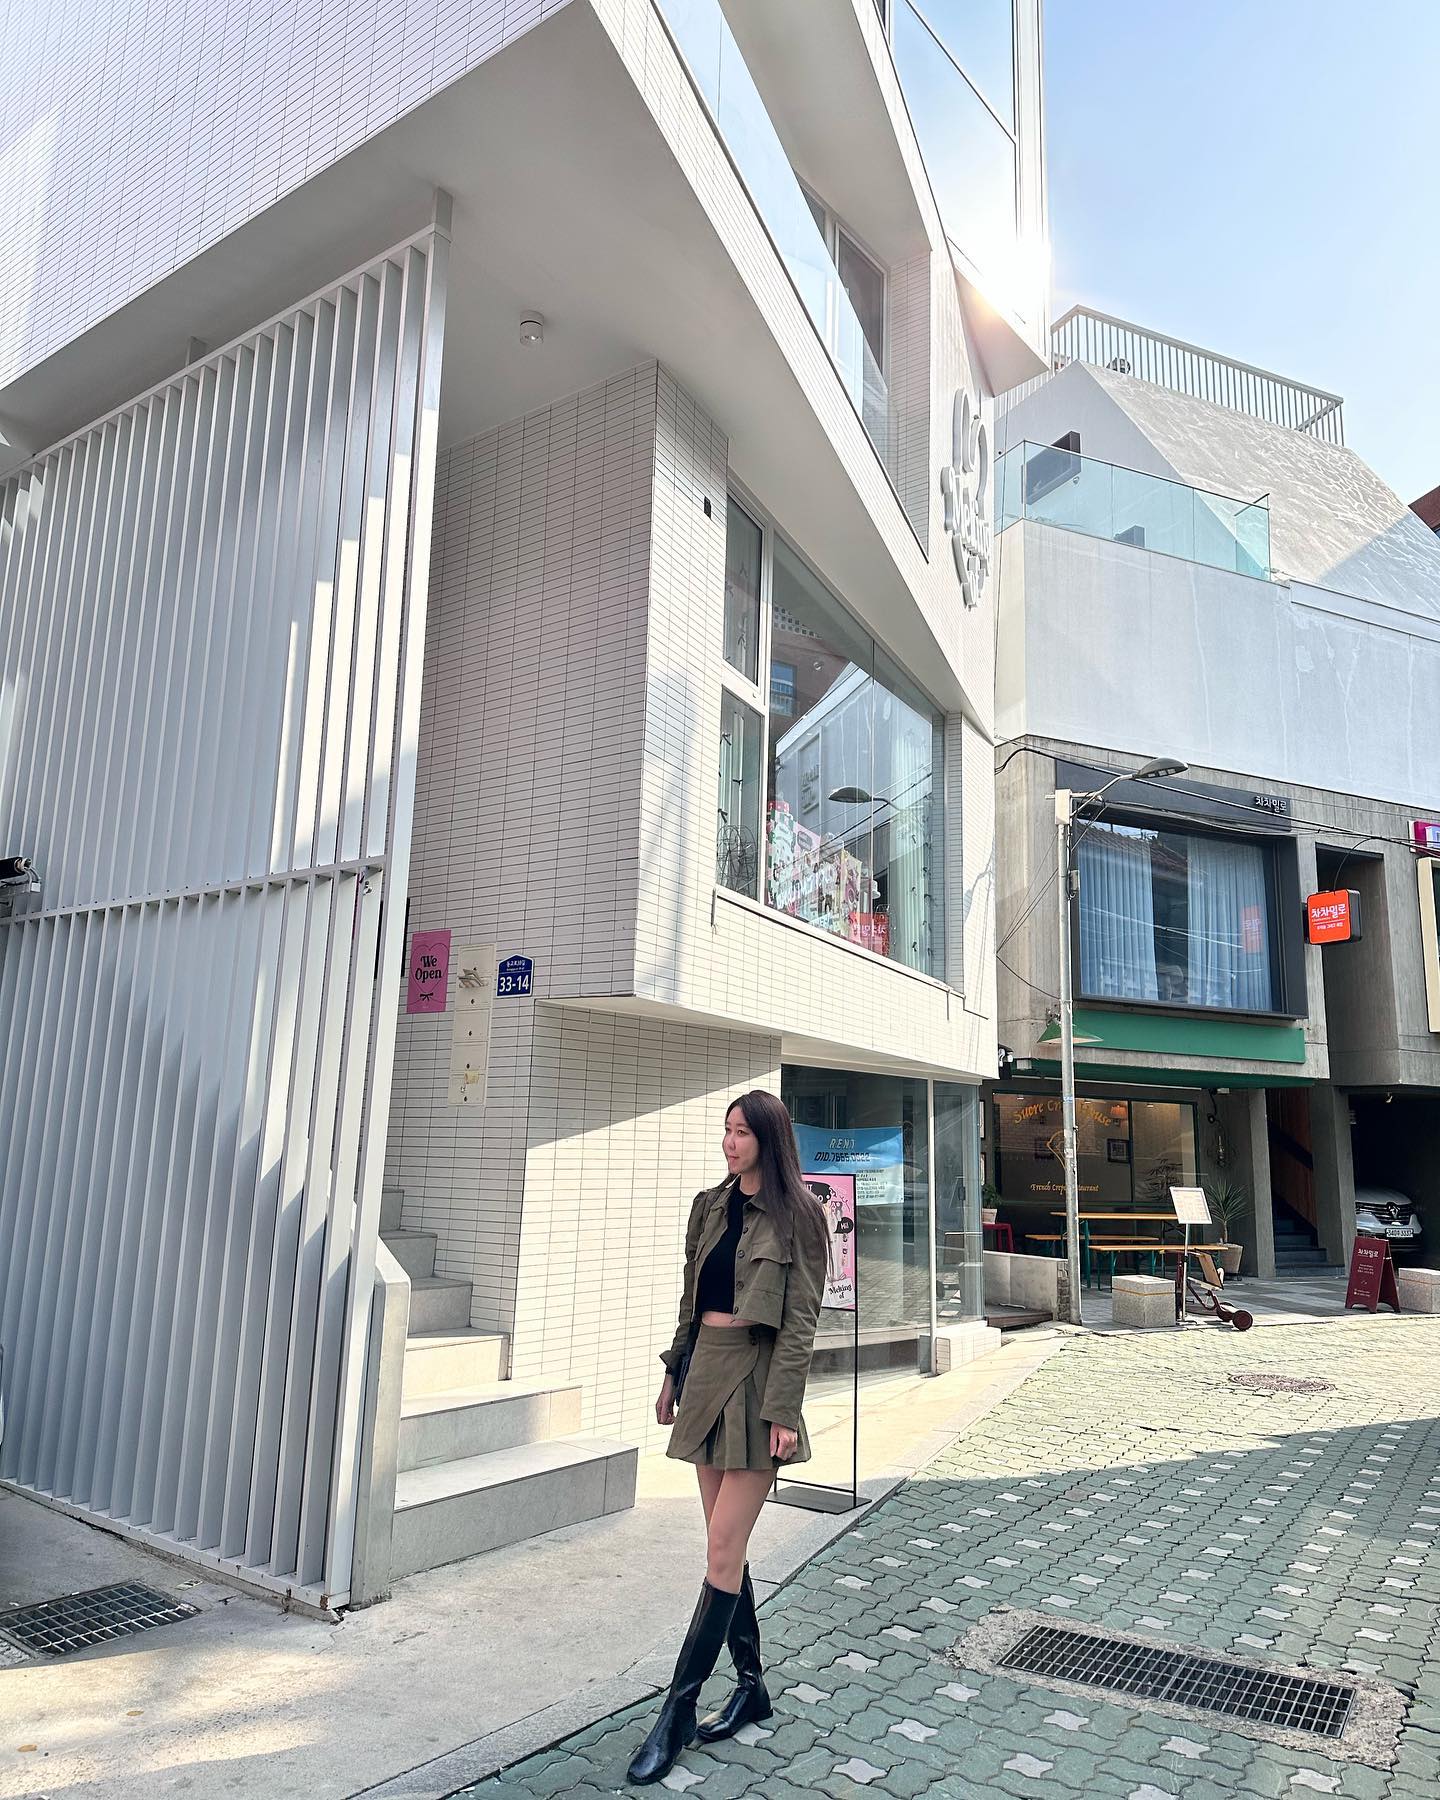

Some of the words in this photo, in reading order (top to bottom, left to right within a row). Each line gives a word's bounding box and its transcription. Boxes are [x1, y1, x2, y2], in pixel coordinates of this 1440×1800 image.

[420, 956, 437, 968] We
[415, 968, 442, 983] Open
[499, 975, 529, 992] 33-14
[1013, 1103, 1044, 1124] Sucre
[1030, 1181, 1051, 1191] French
[839, 1291, 845, 1299] of
